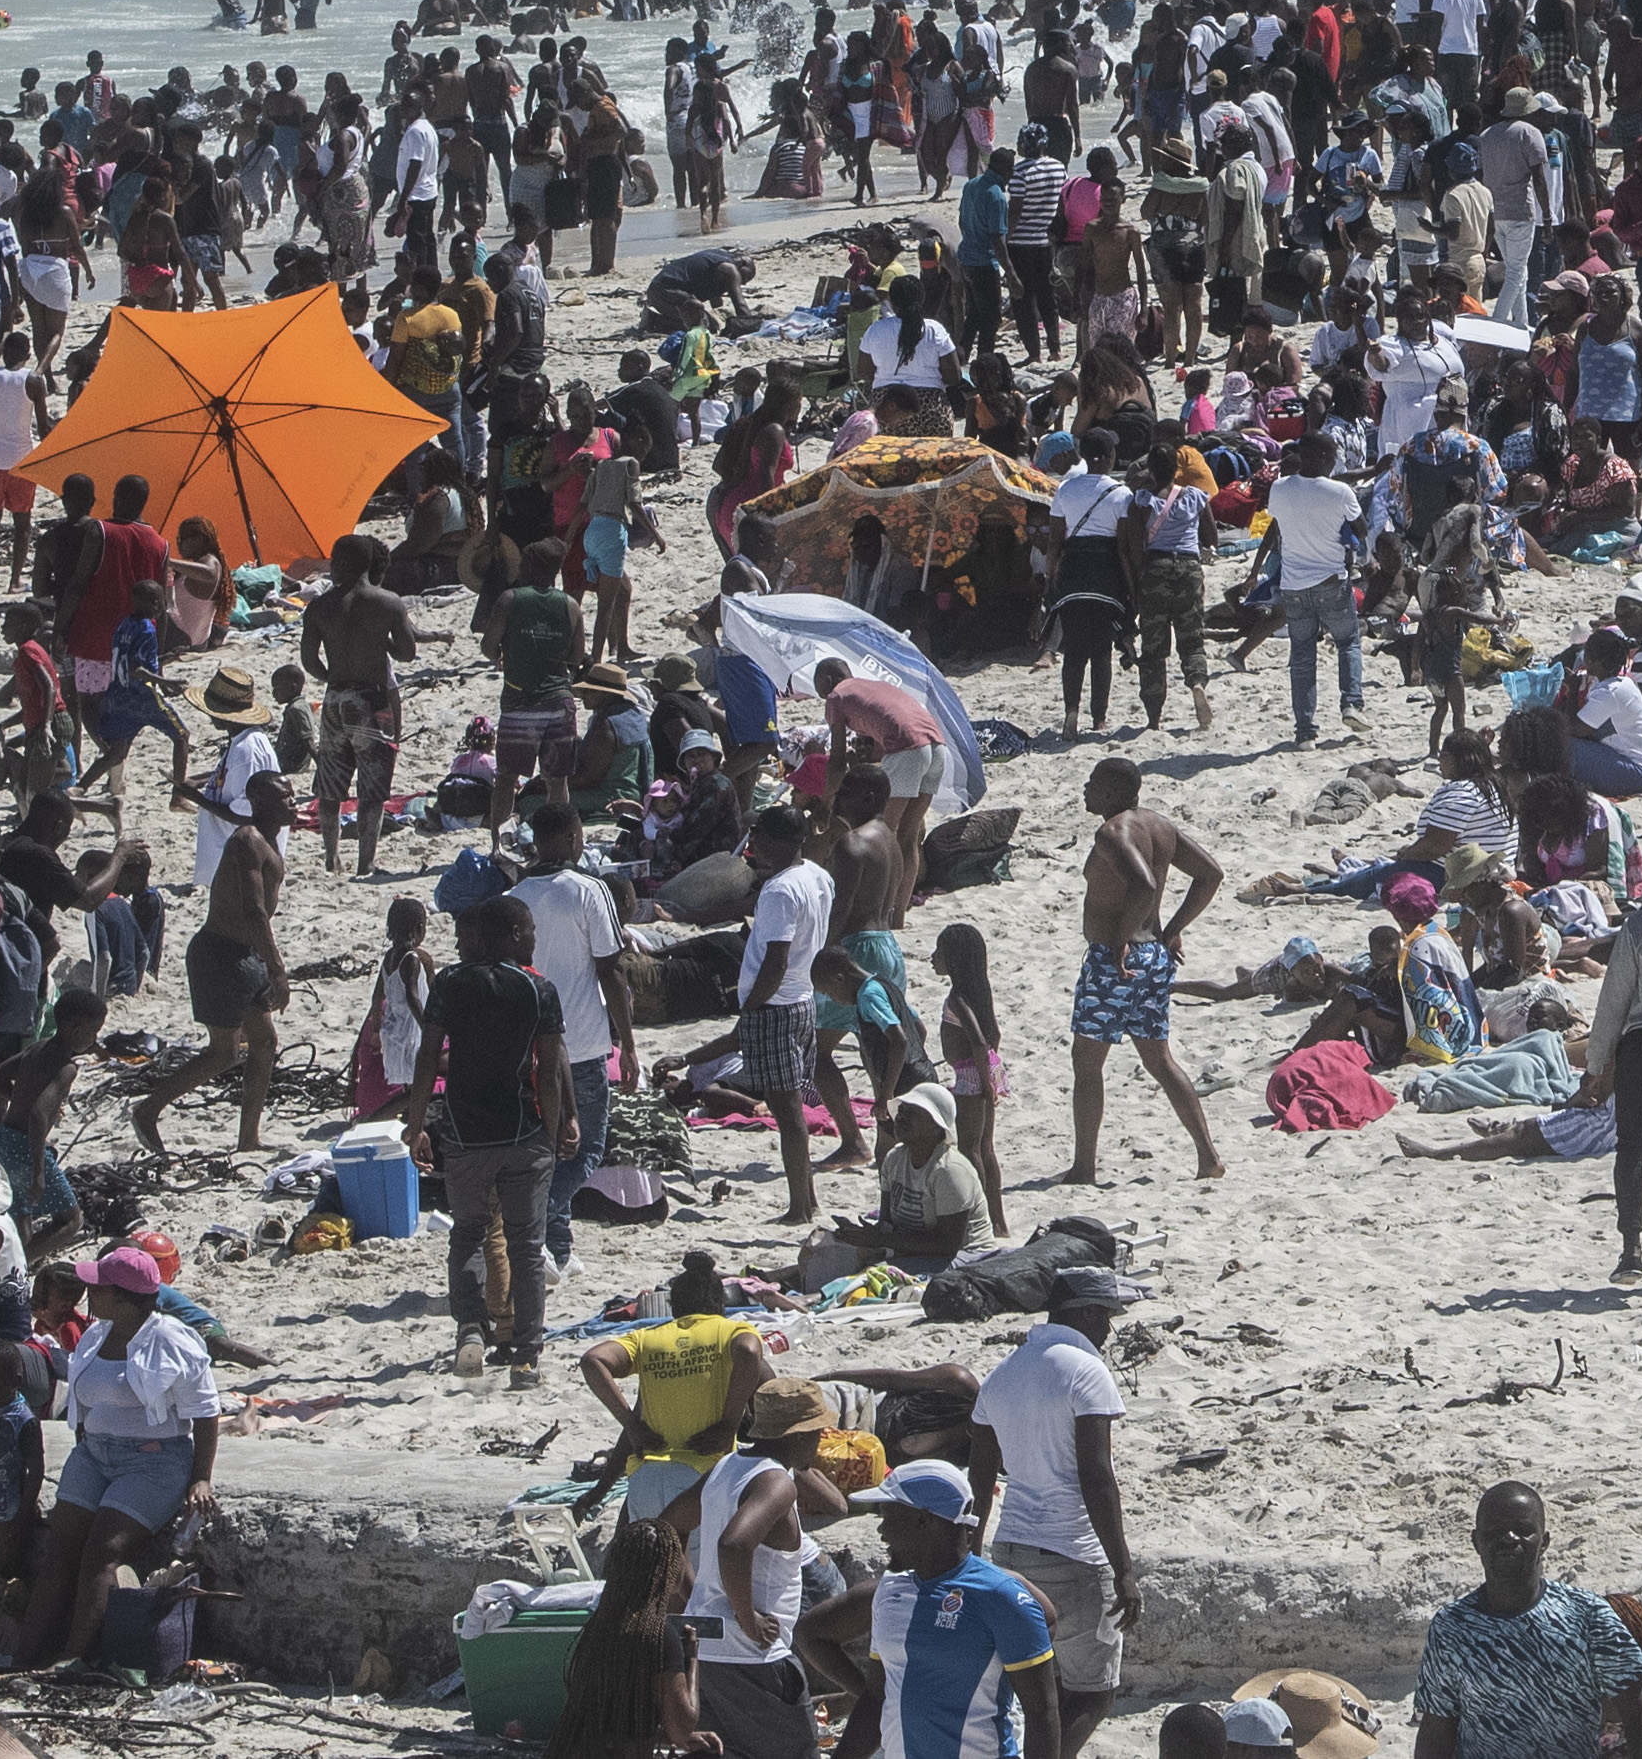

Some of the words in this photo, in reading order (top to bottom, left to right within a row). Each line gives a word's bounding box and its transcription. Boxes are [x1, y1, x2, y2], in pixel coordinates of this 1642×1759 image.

[648, 1351, 677, 1362] LET'S
[680, 1344, 717, 1359] GROW
[642, 1361, 679, 1373] SOUTH
[683, 1353, 723, 1367] AFRICA
[653, 1364, 713, 1380] TOGETHER
